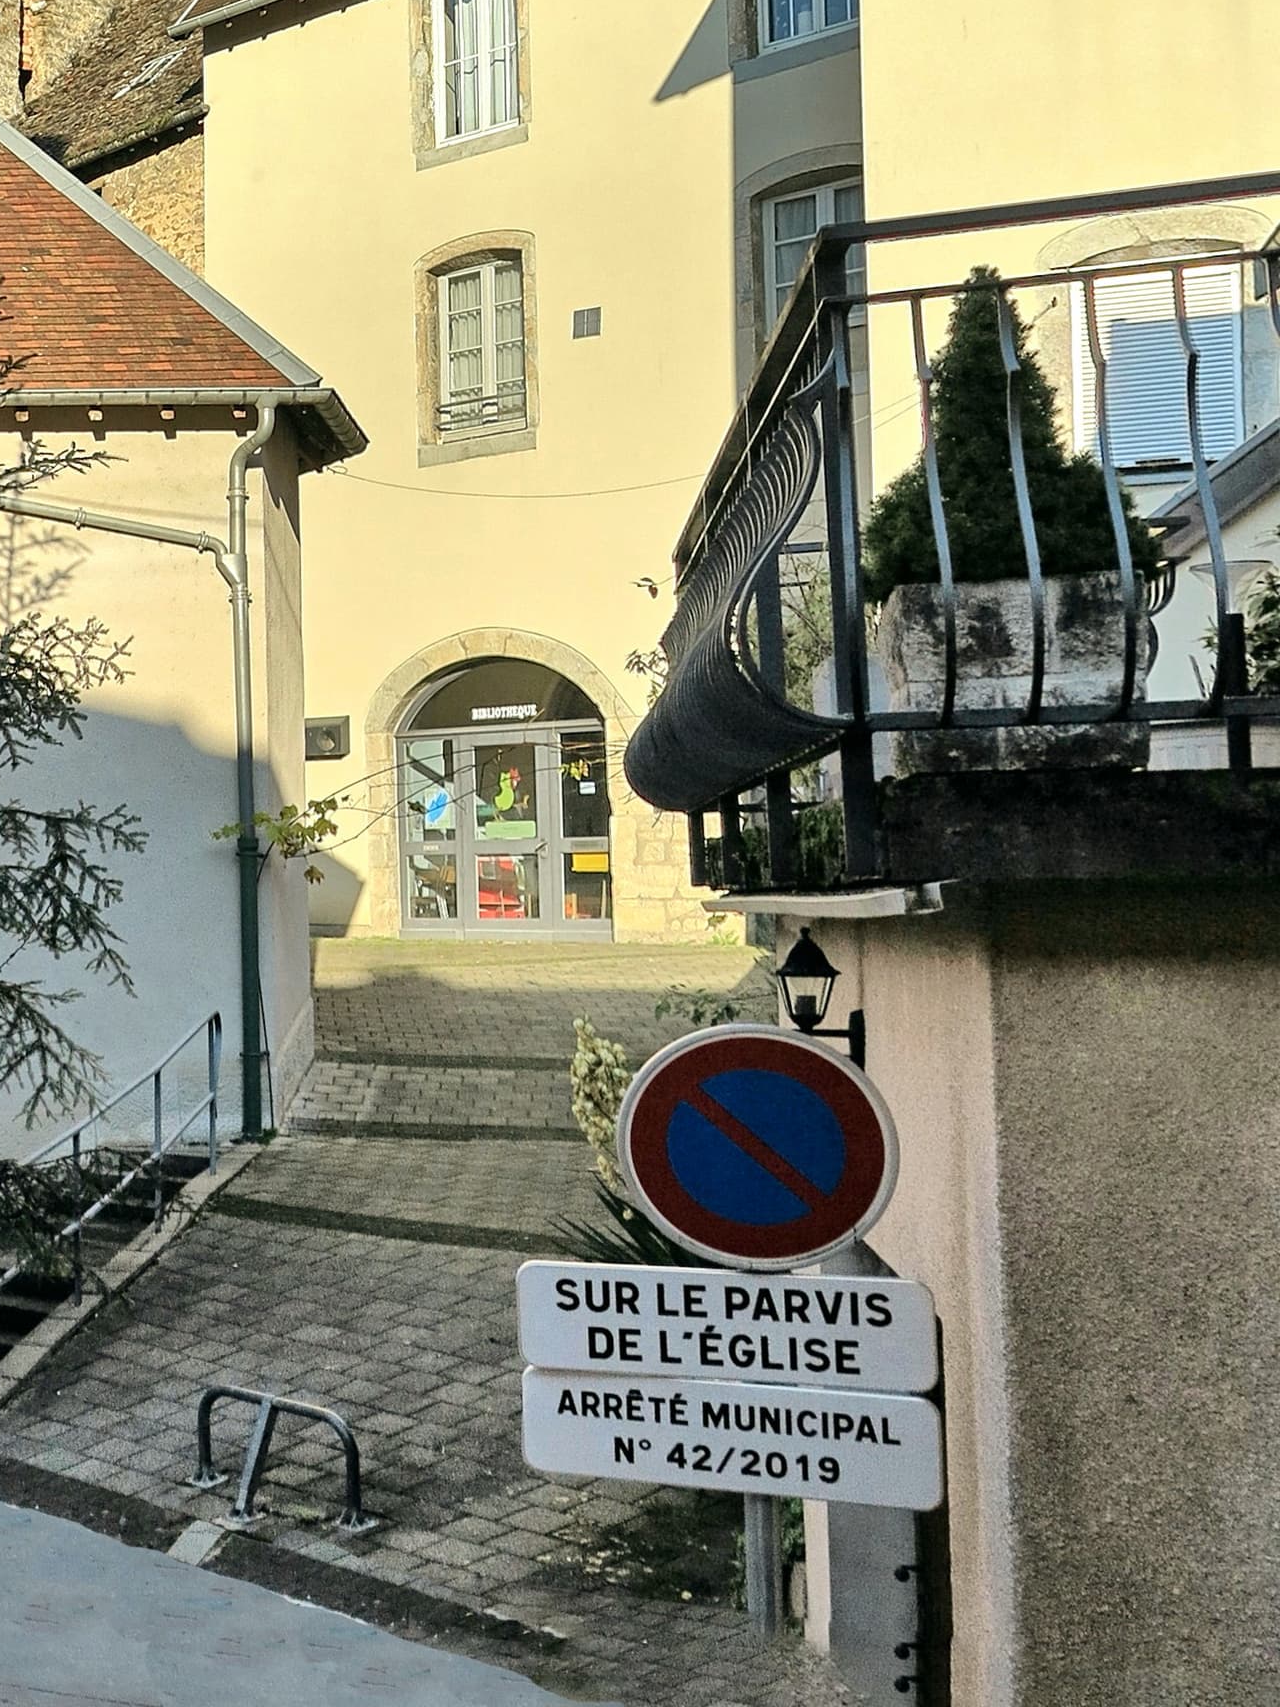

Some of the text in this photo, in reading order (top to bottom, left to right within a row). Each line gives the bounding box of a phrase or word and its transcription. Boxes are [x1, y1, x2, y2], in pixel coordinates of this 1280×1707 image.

[471, 704, 538, 720] BIBLIOTHEQUE
[555, 1278, 893, 1328] SUR LE PARVIS
[587, 1324, 861, 1376] DE L'ÉGLISE
[557, 1388, 902, 1446] ARRÊTÉ MUNICIPAL
[613, 1436, 841, 1485] N° 42/2019
